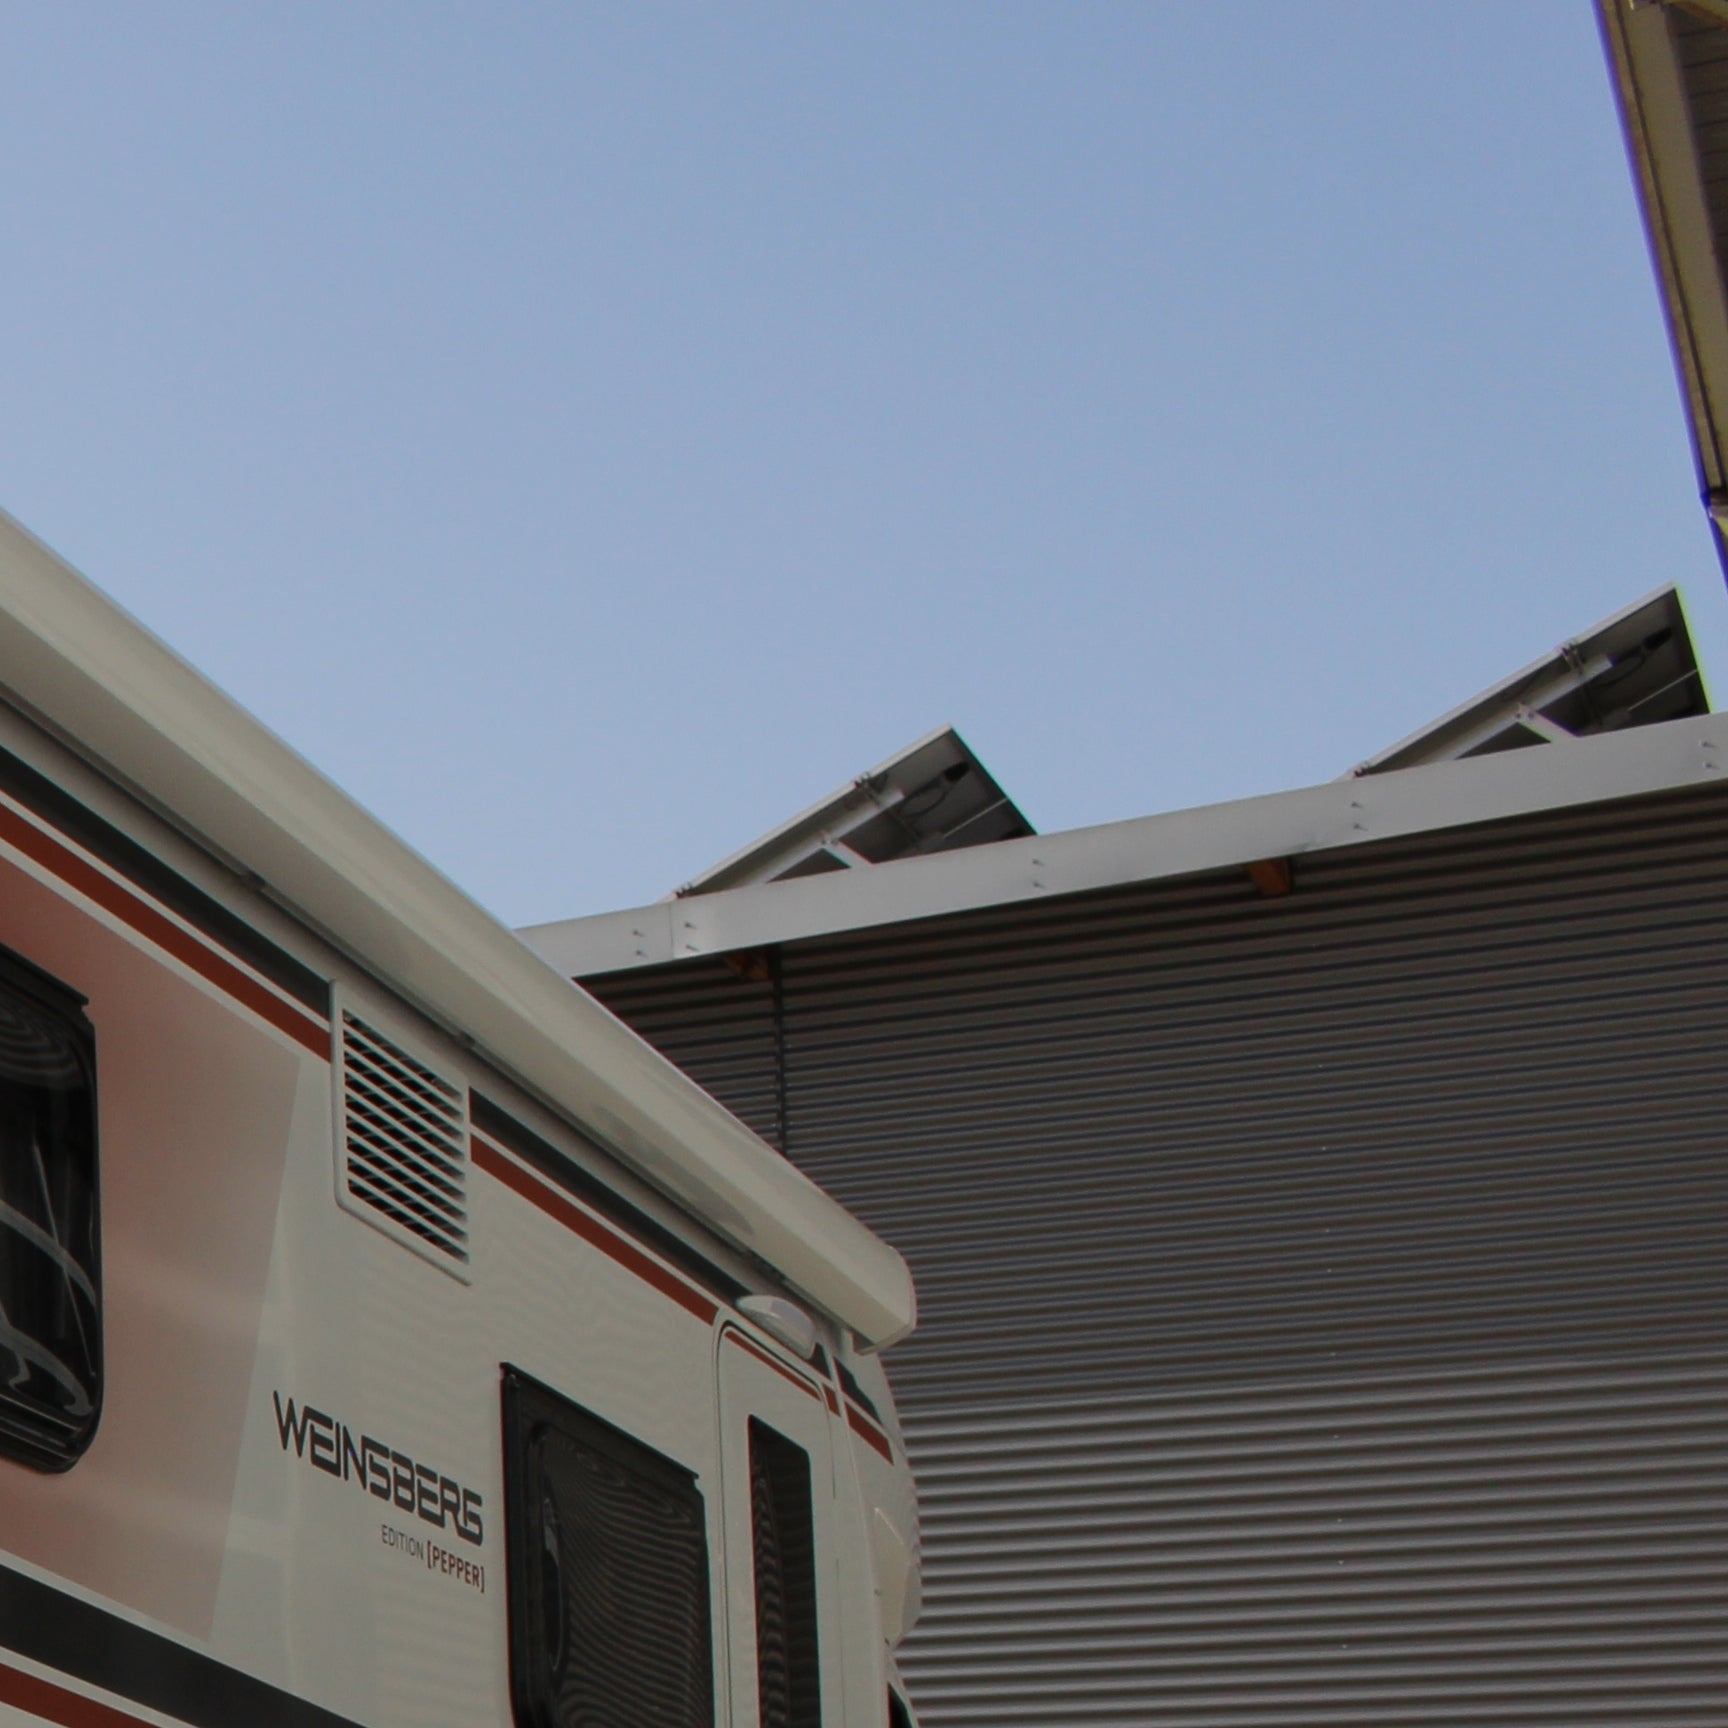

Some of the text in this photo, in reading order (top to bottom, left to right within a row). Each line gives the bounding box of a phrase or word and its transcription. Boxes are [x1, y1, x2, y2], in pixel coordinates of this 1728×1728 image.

[273, 1390, 483, 1546] WEINSBERG
[381, 1524, 485, 1593] EDITION [PEPPER]
